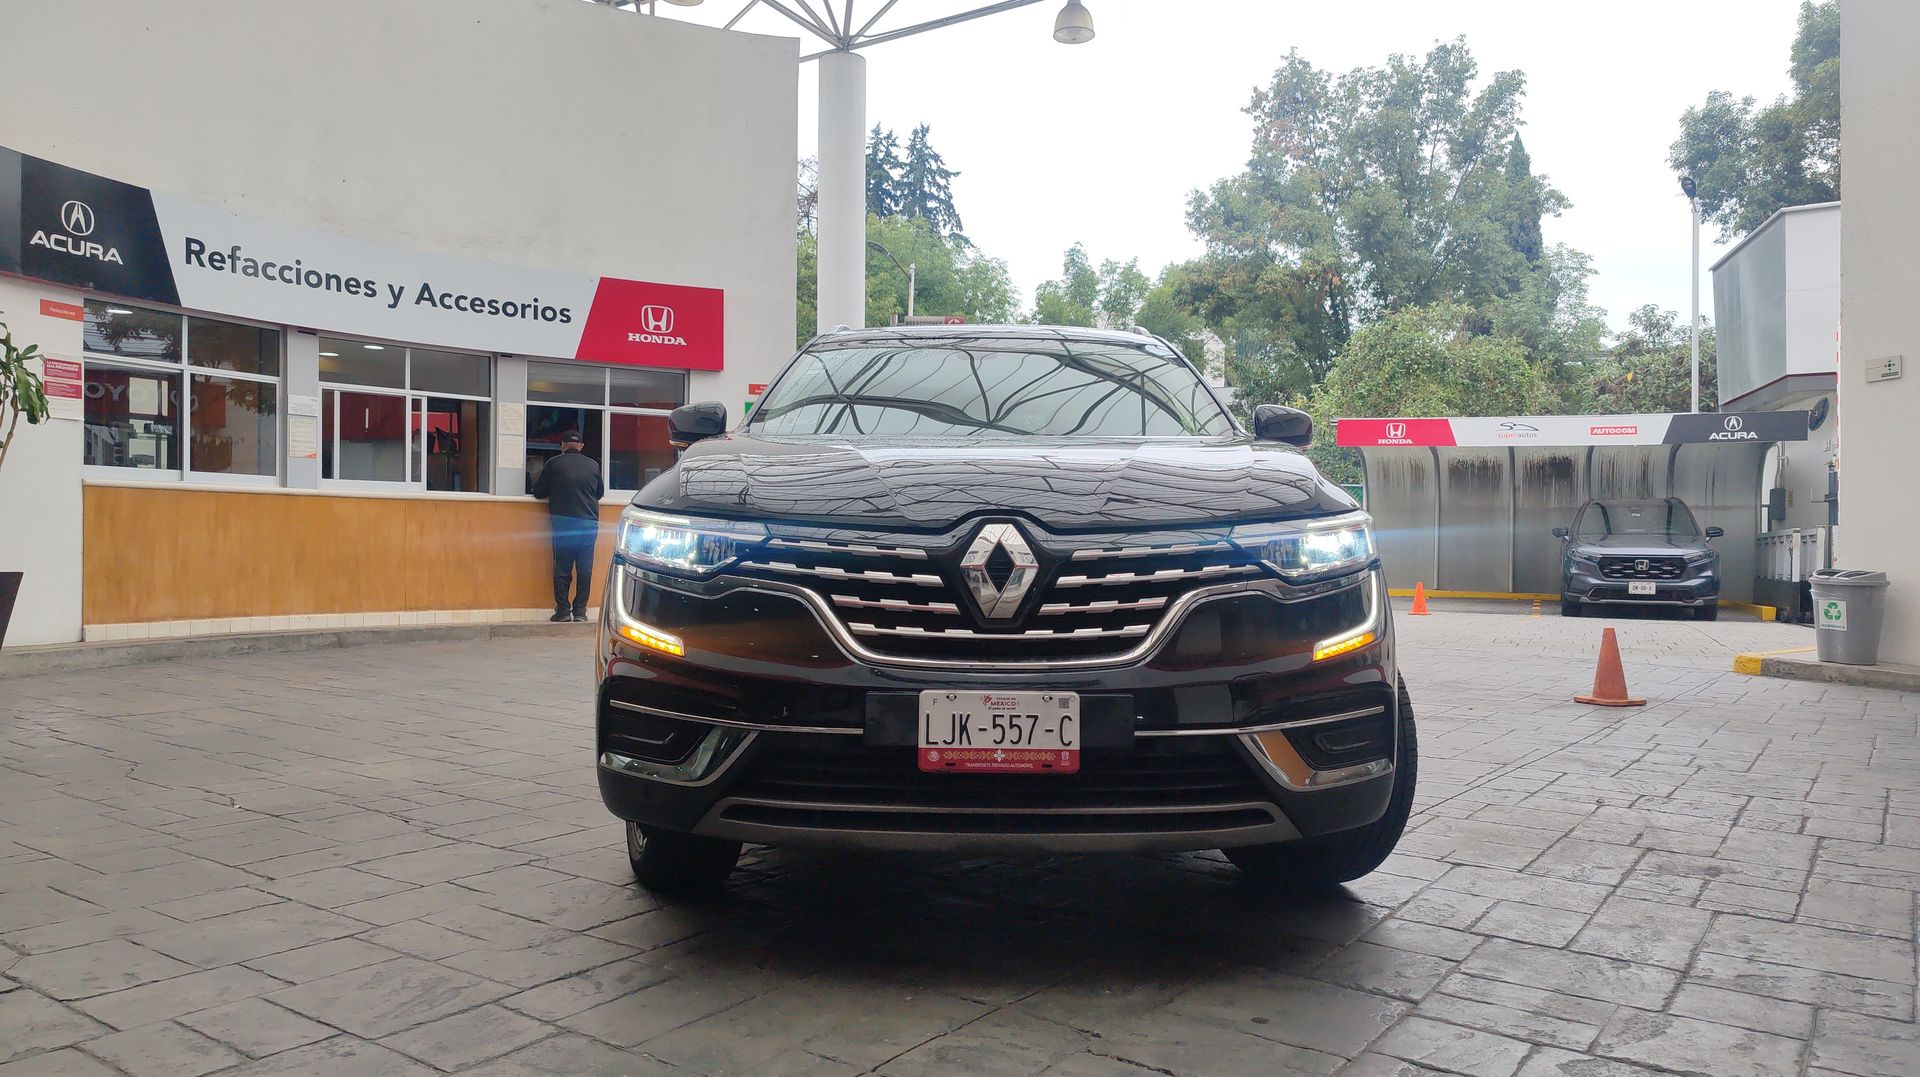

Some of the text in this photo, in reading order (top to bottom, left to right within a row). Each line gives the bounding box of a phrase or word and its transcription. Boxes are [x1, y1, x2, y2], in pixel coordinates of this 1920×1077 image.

[28, 229, 125, 265] ACURA
[184, 236, 573, 325] Refacciones y Accesorios
[627, 332, 688, 346] HONDA
[1497, 431, 1538, 439] superautos
[1592, 427, 1636, 435] AUTOCOM
[1708, 430, 1759, 440] ACURA
[925, 713, 1073, 747] LJK-557-C
